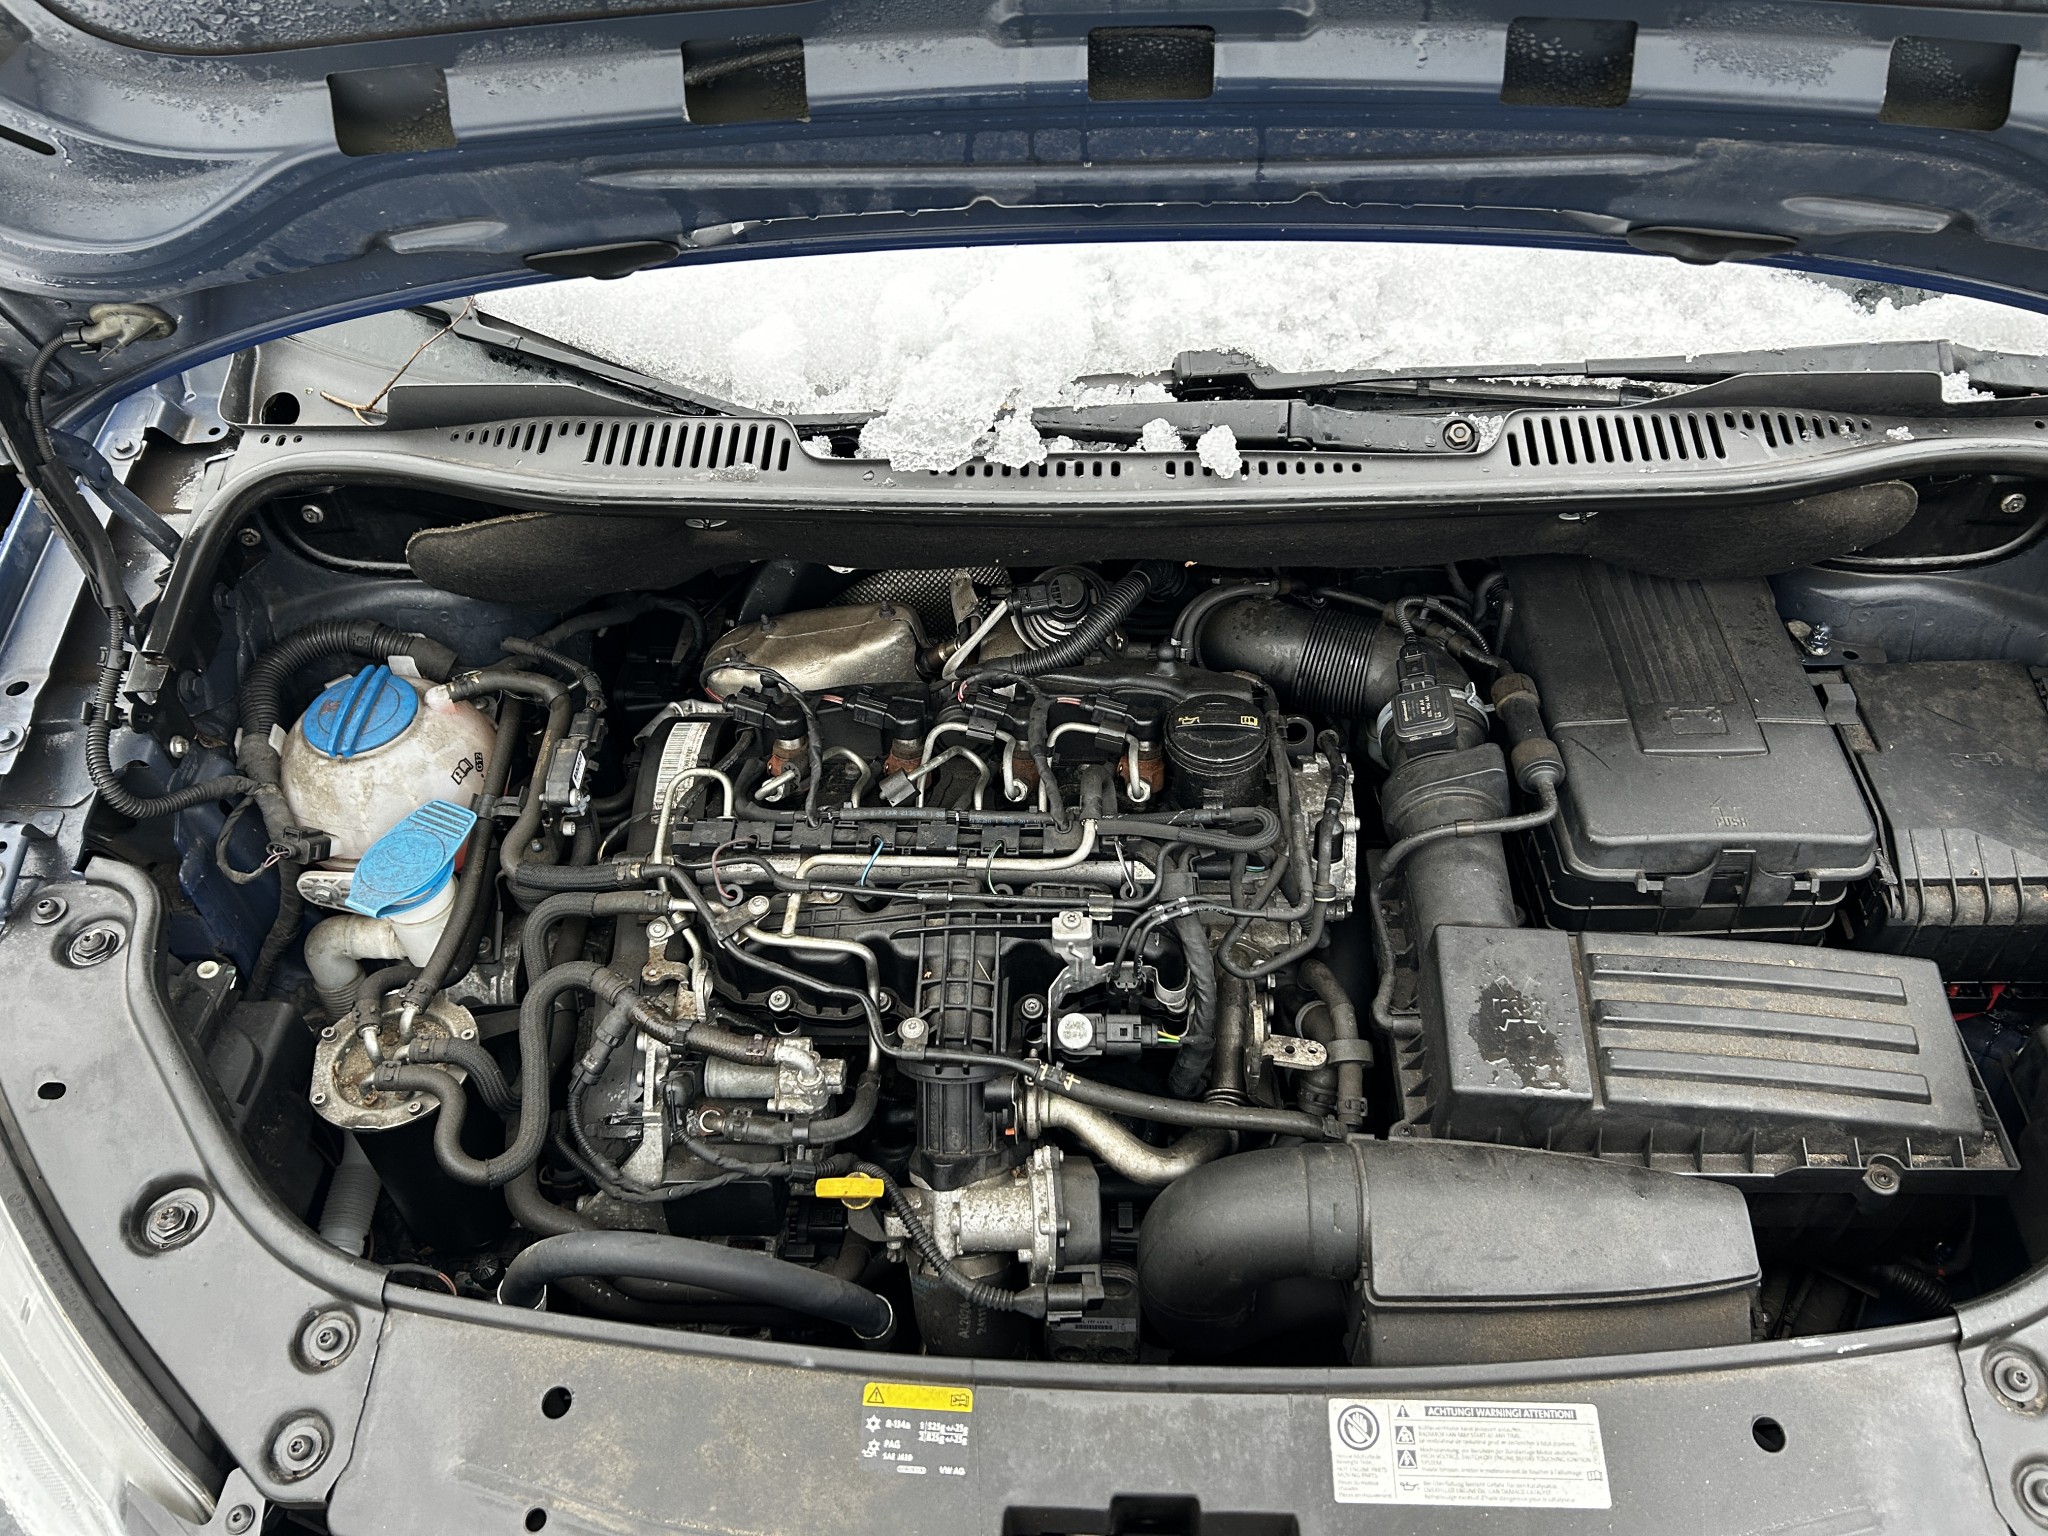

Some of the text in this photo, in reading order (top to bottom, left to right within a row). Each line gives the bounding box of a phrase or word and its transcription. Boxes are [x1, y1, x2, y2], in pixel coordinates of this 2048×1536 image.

[475, 752, 484, 772] G12
[1714, 817, 1748, 828] PUSH
[1428, 1407, 1574, 1419] ACHTUNG! WARNING! ATTENTION!
[884, 1439, 901, 1450] PAG
